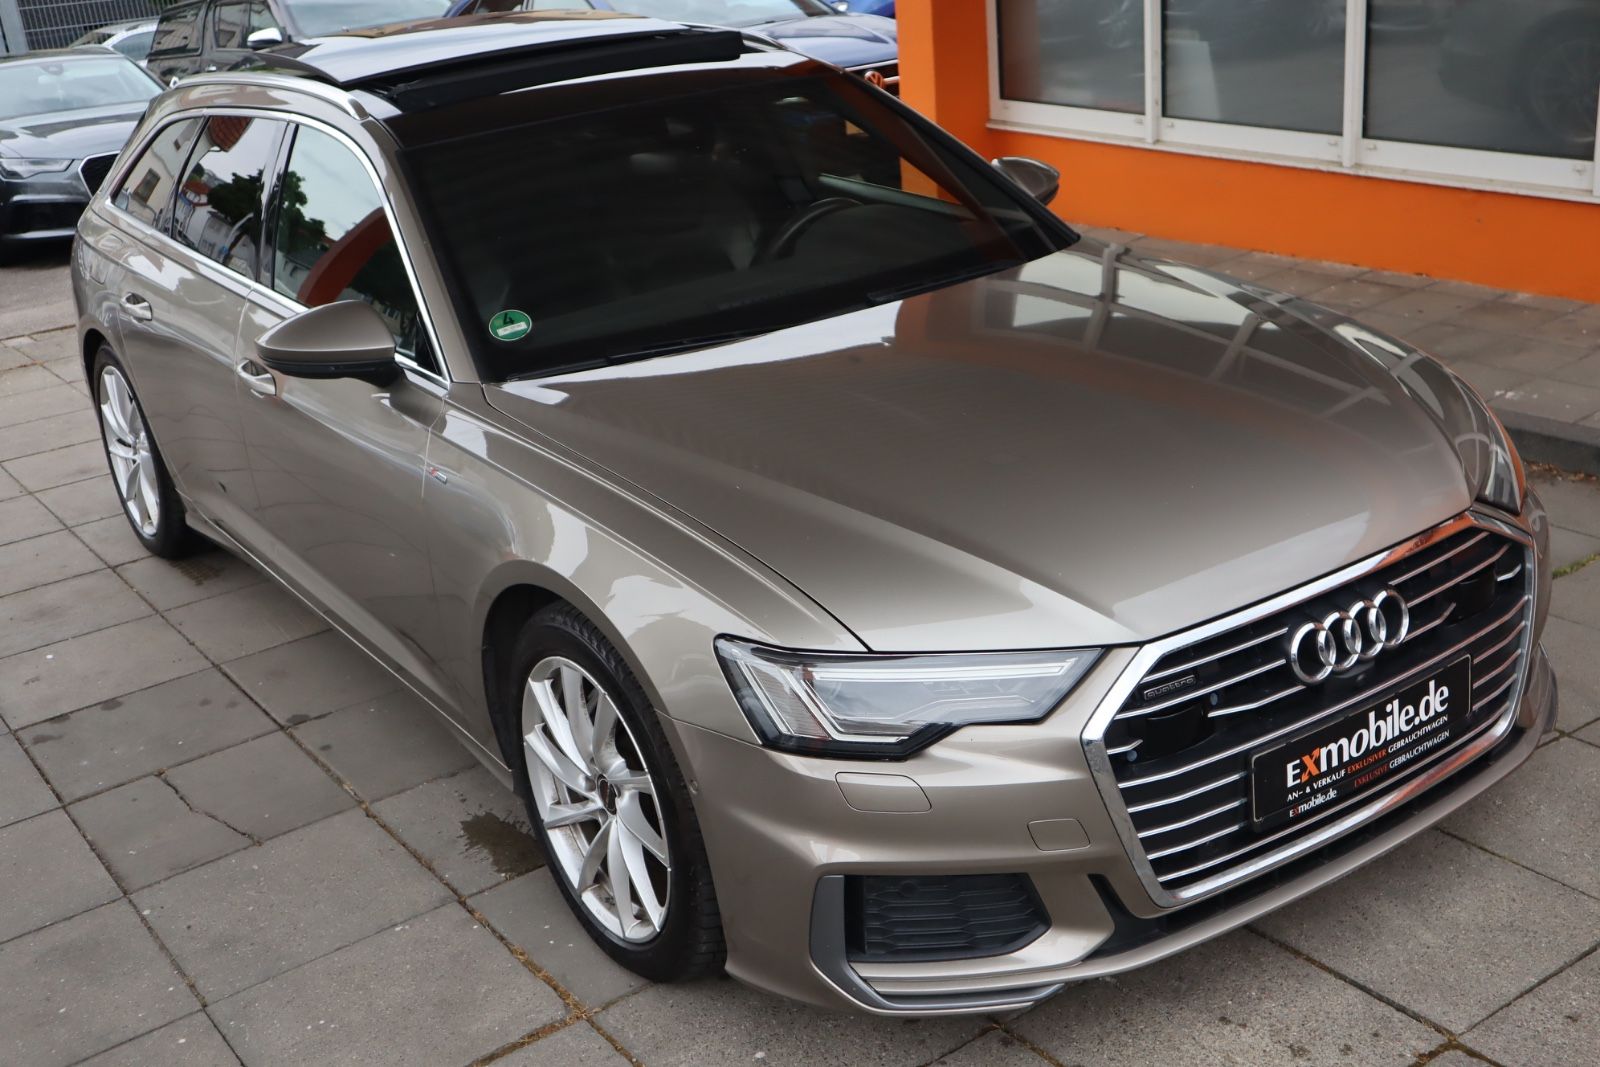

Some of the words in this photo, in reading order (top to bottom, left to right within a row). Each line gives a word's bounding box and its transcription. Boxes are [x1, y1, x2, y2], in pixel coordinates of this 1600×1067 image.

[503, 312, 514, 325] 4
[1147, 677, 1195, 698] quattro
[1313, 769, 1346, 790] VERKAUF
[1347, 749, 1387, 774] EXKLUSIVER
[1388, 714, 1449, 753] GEBRAUCHTWAGEN
[1389, 729, 1450, 769] GEBRAUCHTWAGEN
